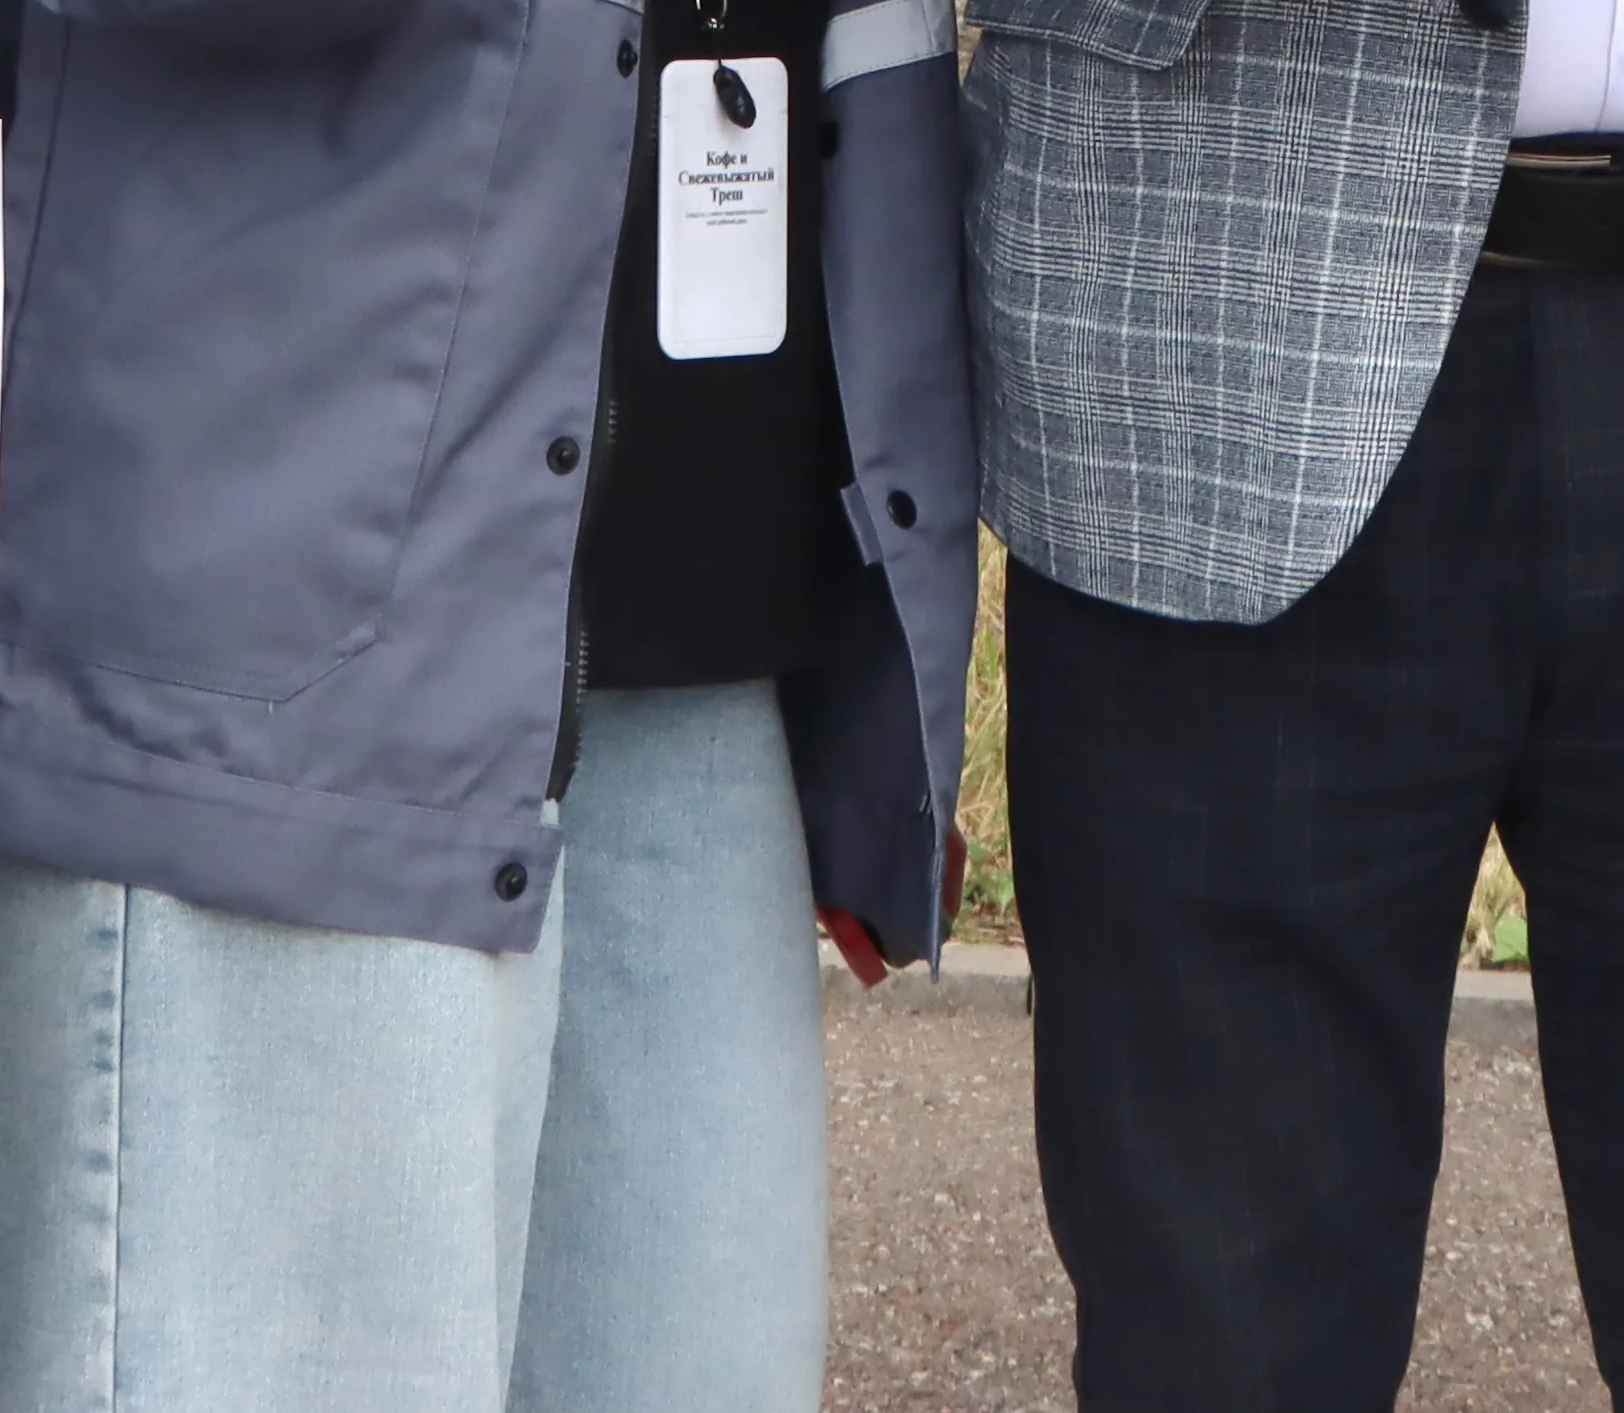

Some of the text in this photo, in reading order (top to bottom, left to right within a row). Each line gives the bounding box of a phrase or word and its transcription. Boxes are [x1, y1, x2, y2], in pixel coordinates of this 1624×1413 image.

[706, 150, 748, 169] Кофе и
[678, 167, 775, 186] Свежевыжатый
[710, 187, 743, 206] Треш
